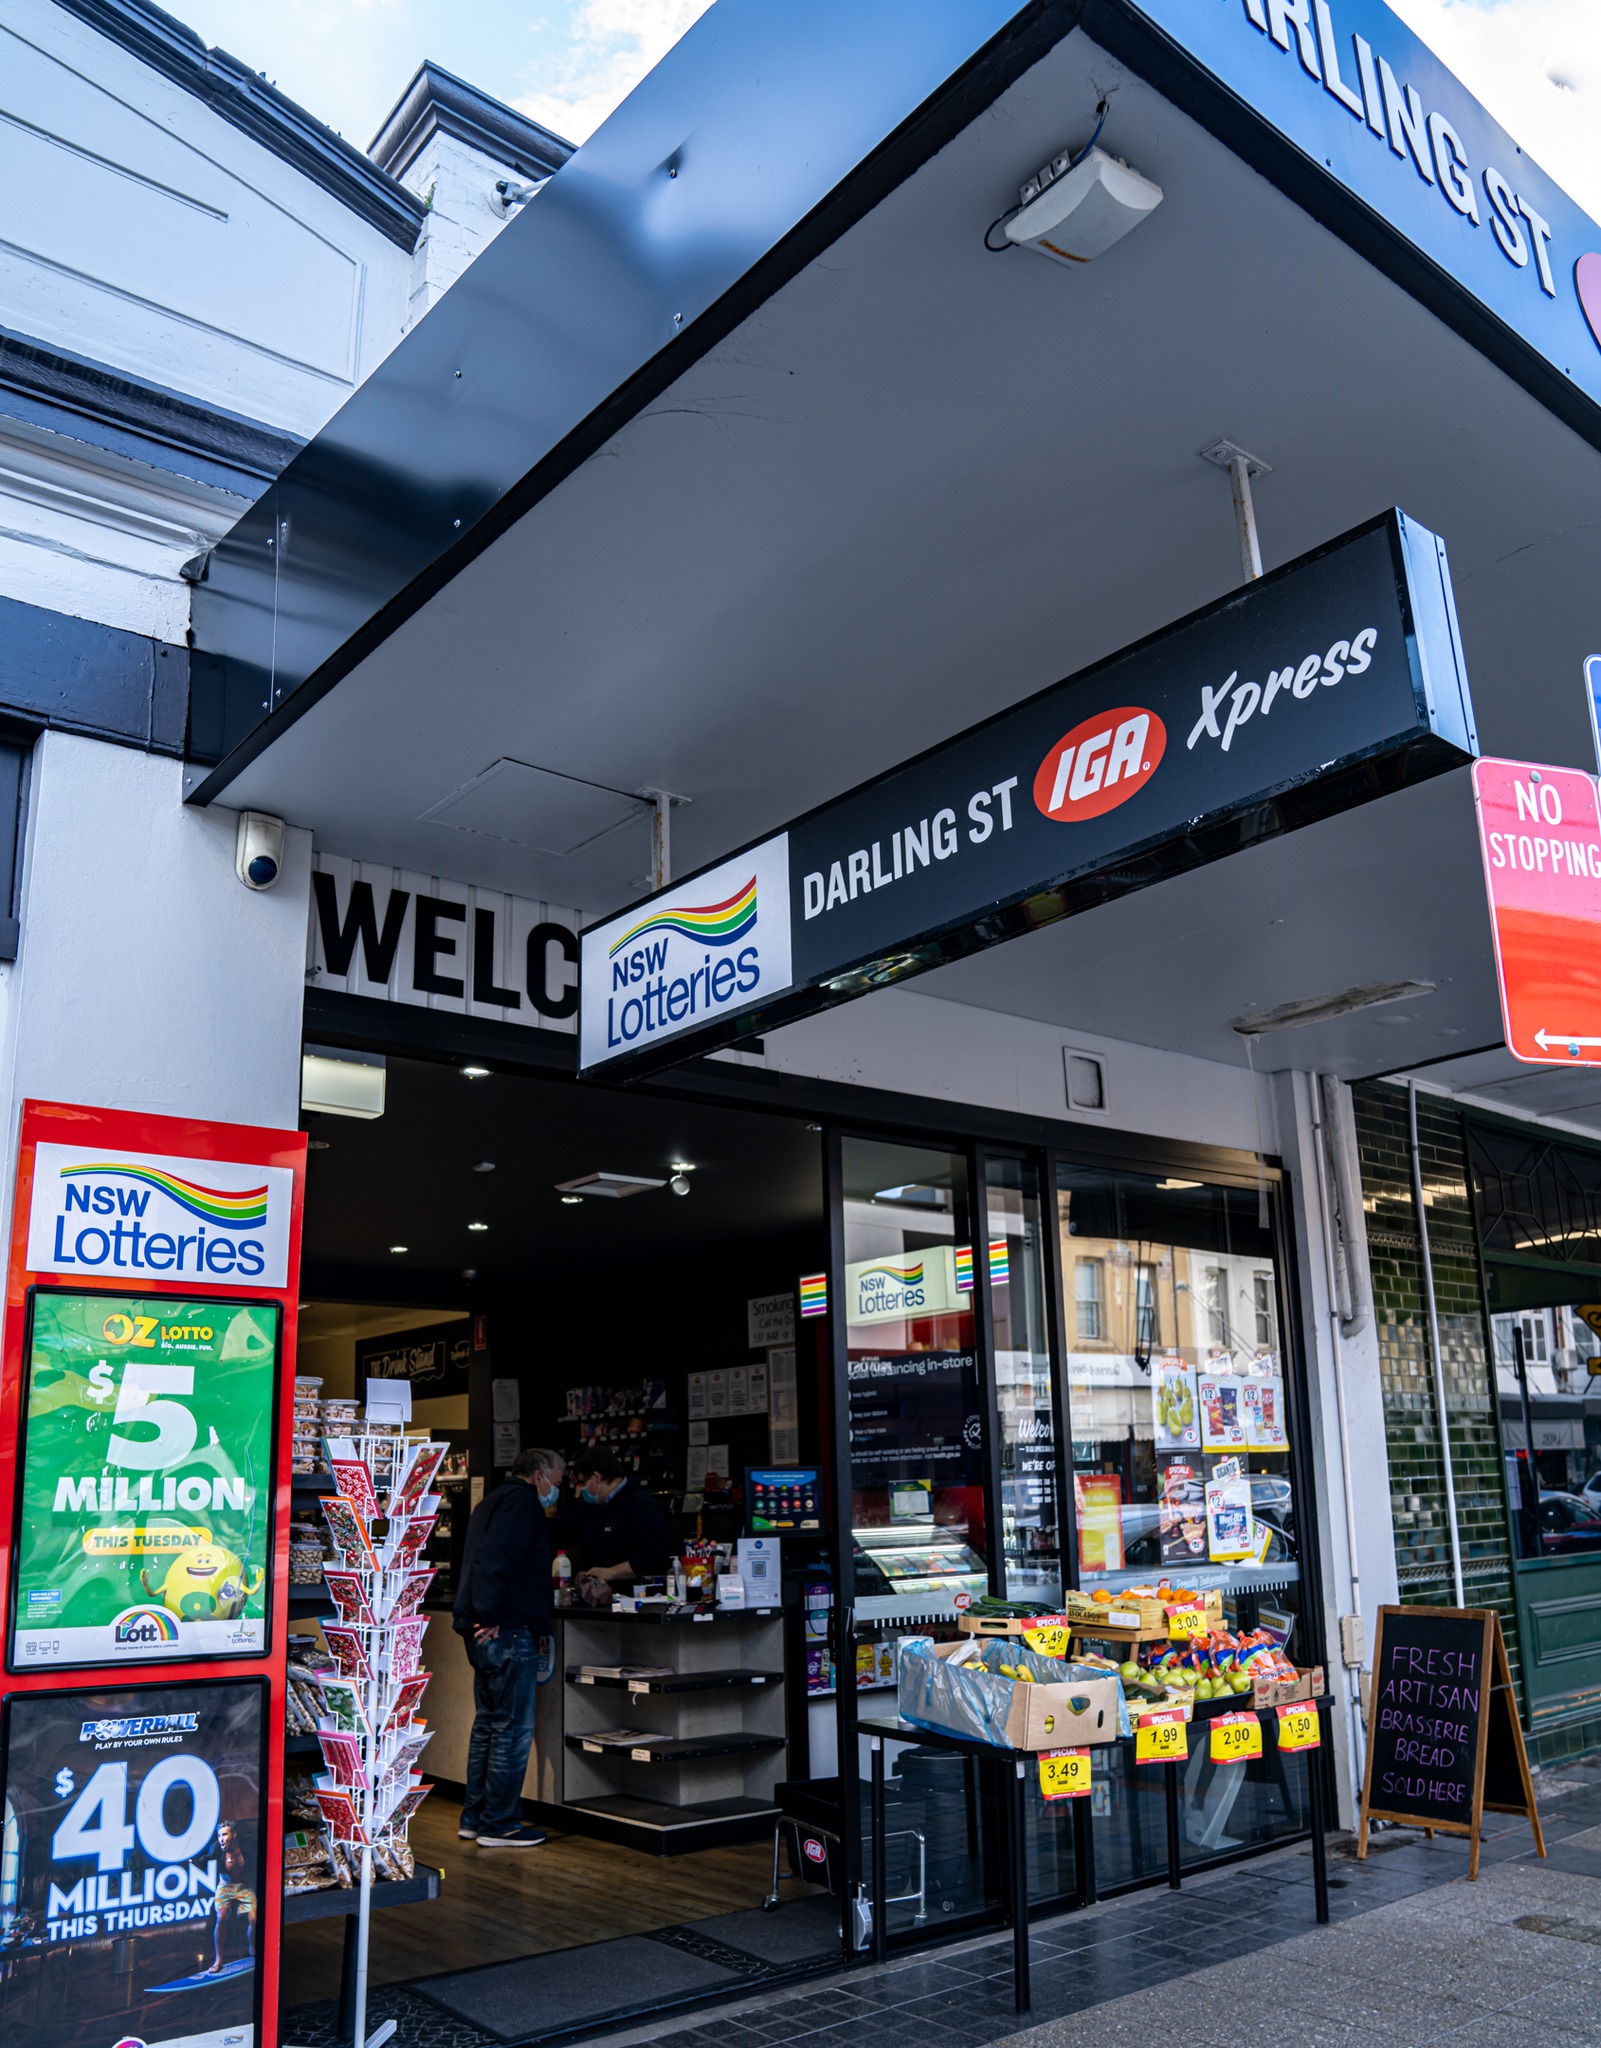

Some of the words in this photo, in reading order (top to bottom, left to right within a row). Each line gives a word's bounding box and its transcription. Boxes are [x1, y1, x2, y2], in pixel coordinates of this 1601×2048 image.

[1483, 167, 1556, 299] ST
[803, 809, 958, 922] DARLING
[968, 777, 1019, 845] ST
[1046, 713, 1150, 813] IGA
[1187, 628, 1378, 752] Xpress
[1514, 780, 1563, 826] NO
[611, 937, 669, 993] NSW
[606, 946, 761, 1049] Lotteries
[64, 1183, 152, 1218] NSW
[53, 1214, 267, 1276] Lotteries
[860, 1277, 886, 1293] NSW
[859, 1288, 925, 1315] Lotteries
[102, 1313, 160, 1348] OZ
[160, 1326, 214, 1341] LOTTO
[926, 1356, 973, 1372] in-store
[52, 1476, 247, 1513] MILLION
[94, 1534, 130, 1548] THIS
[134, 1534, 202, 1548] TUESDAY
[115, 1624, 158, 1643] Lott
[1037, 1630, 1063, 1644] 2.49
[1176, 1614, 1198, 1630] 3.00
[1392, 1646, 1476, 1680] FRESH
[1381, 1679, 1479, 1712] ARTISAN
[80, 1712, 198, 1742] POWERBALL
[1151, 1714, 1174, 1725] SPECIAL
[1222, 1714, 1246, 1725] SPECIAL
[1288, 1718, 1310, 1733] 1.50
[1380, 1708, 1469, 1744] BRASSERIE
[95, 1742, 112, 1750] PLAY
[113, 1740, 122, 1748] BY
[1150, 1728, 1177, 1743] 1.99
[1224, 1728, 1250, 1745] 2.00
[1050, 1748, 1078, 1758] SPECIAL
[1394, 1738, 1455, 1768] BREAD
[1048, 1762, 1078, 1779] 3.49
[1382, 1772, 1426, 1797] SOLD
[1428, 1779, 1466, 1803] HERE
[46, 1859, 222, 1919] MILLION
[46, 1916, 98, 1942] THIS
[104, 1896, 217, 1933] THURSDAY
